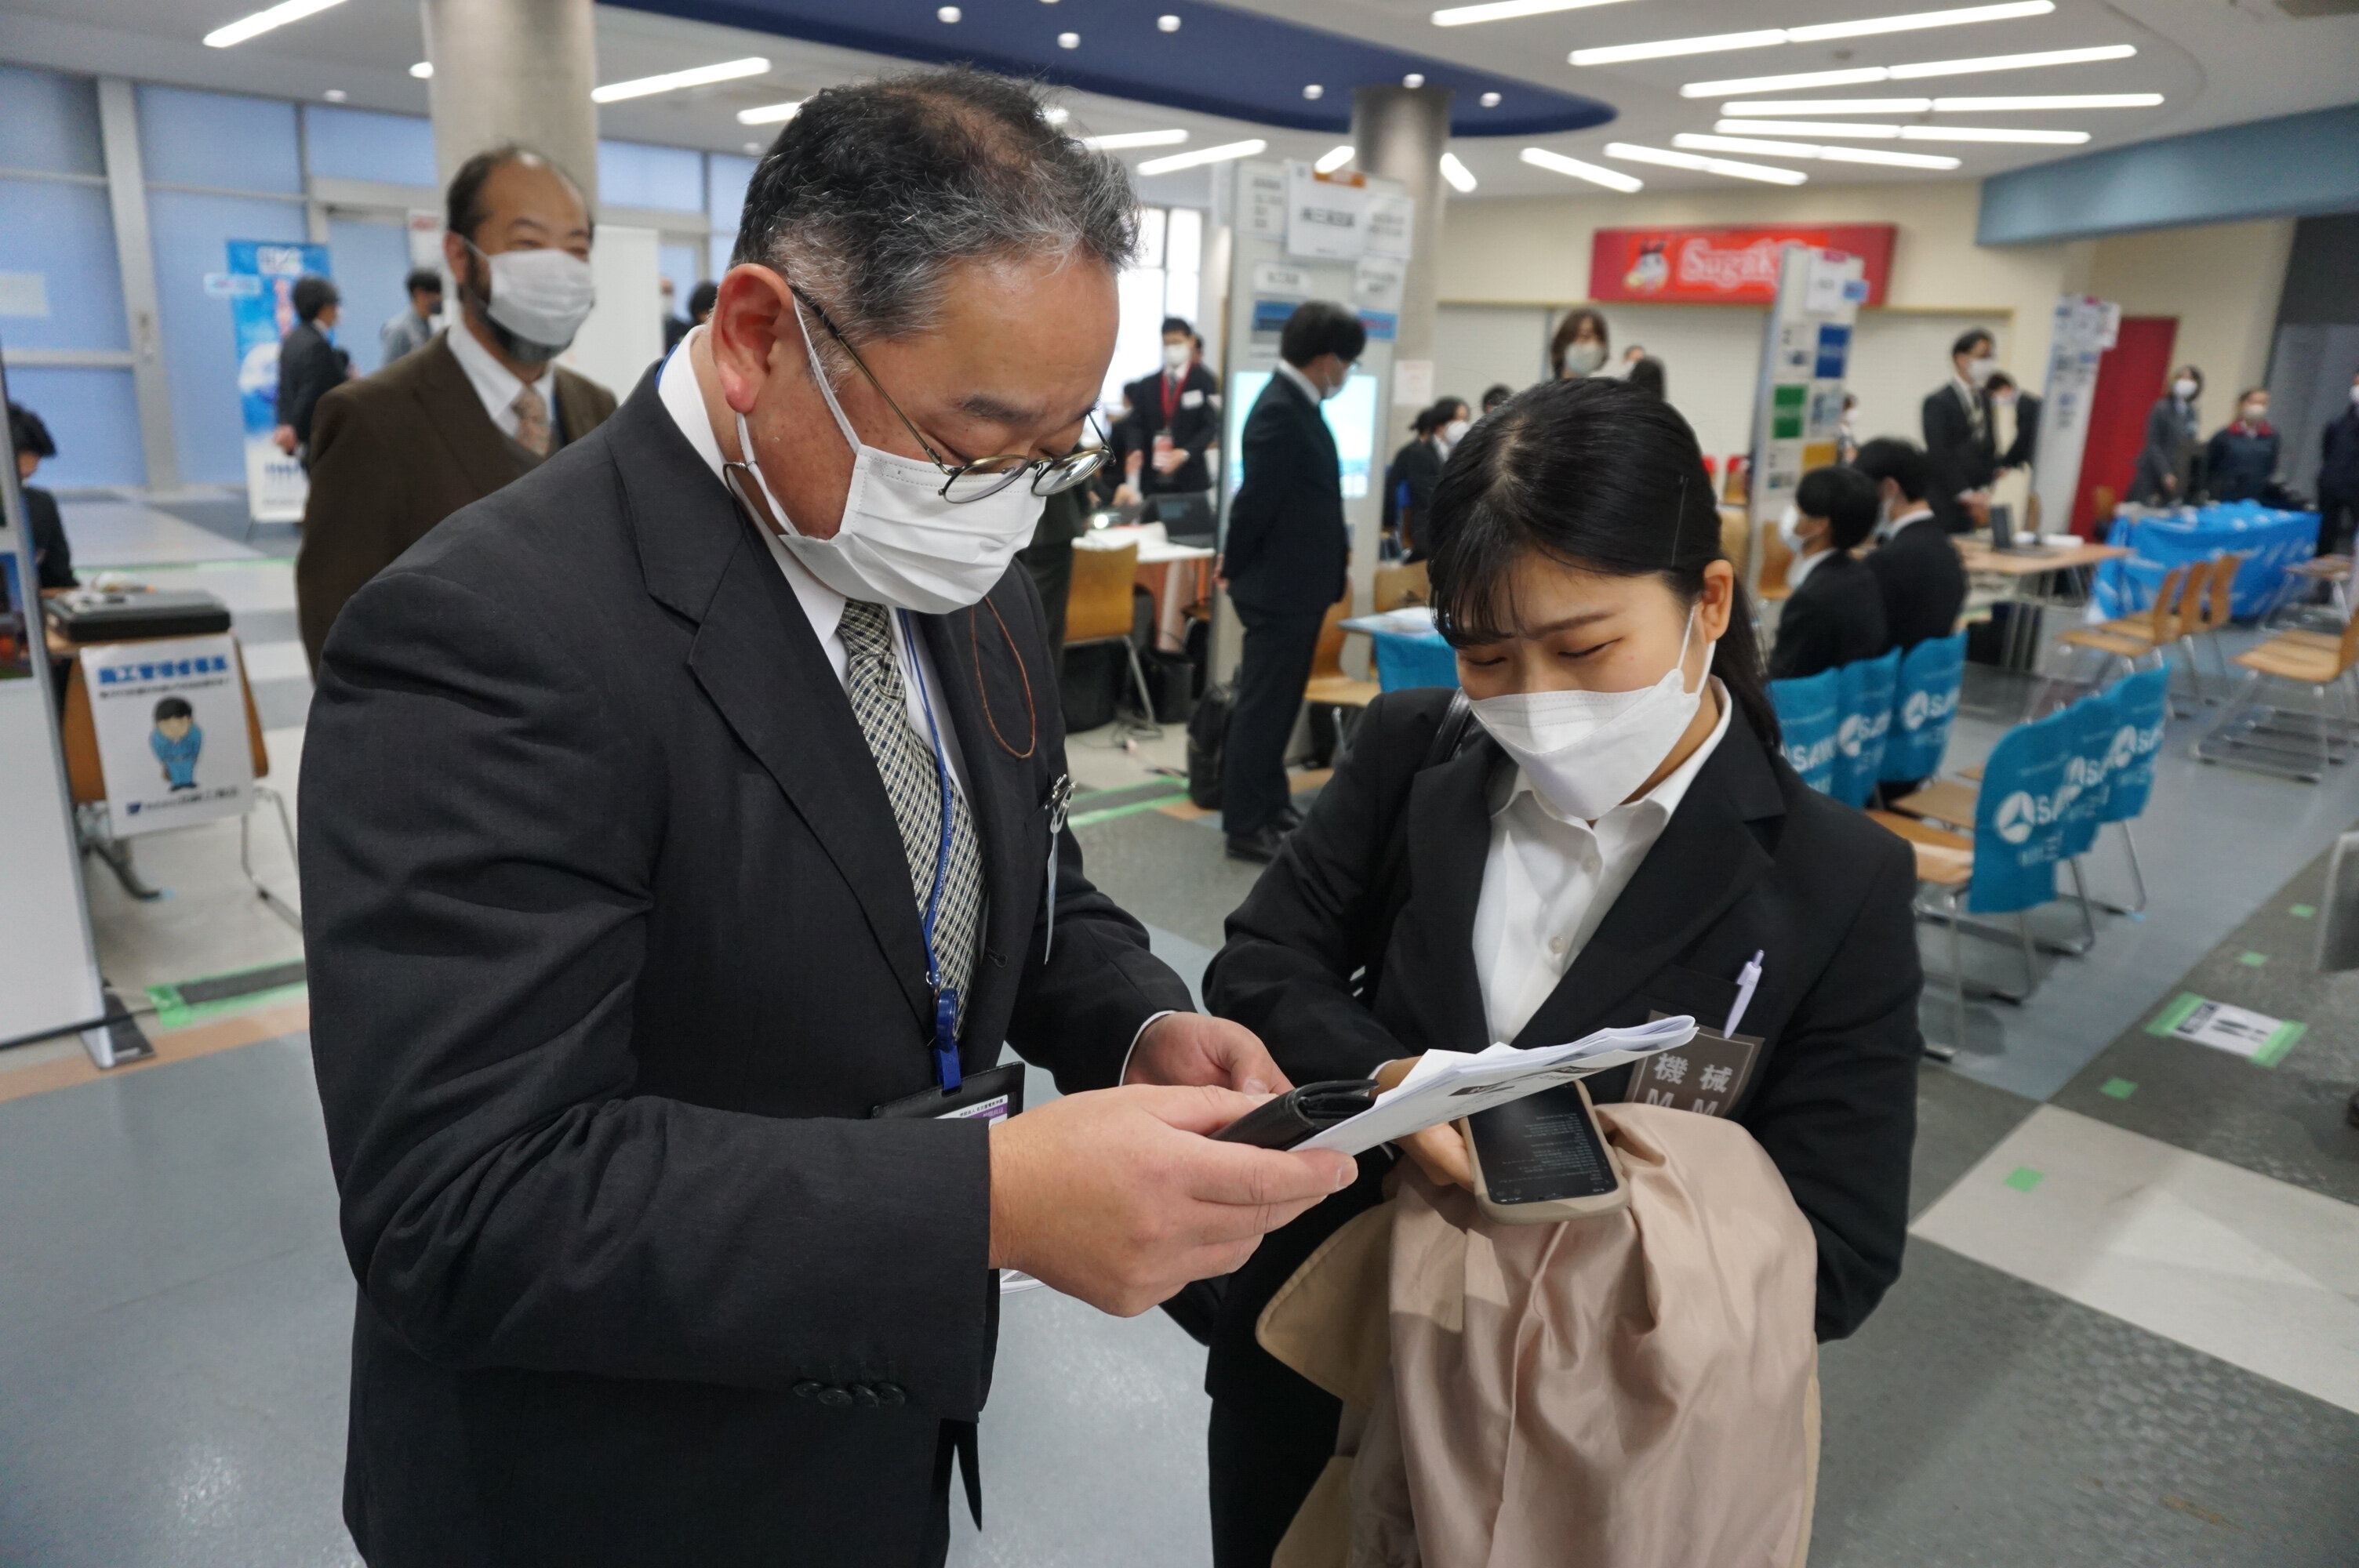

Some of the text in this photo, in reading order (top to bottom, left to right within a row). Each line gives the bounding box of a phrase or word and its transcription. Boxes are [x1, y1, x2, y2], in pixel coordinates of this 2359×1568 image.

[1681, 238, 1781, 289] Sugak
[933, 845, 950, 911] FOUNDATION
[1654, 1052, 1733, 1093] 機械
